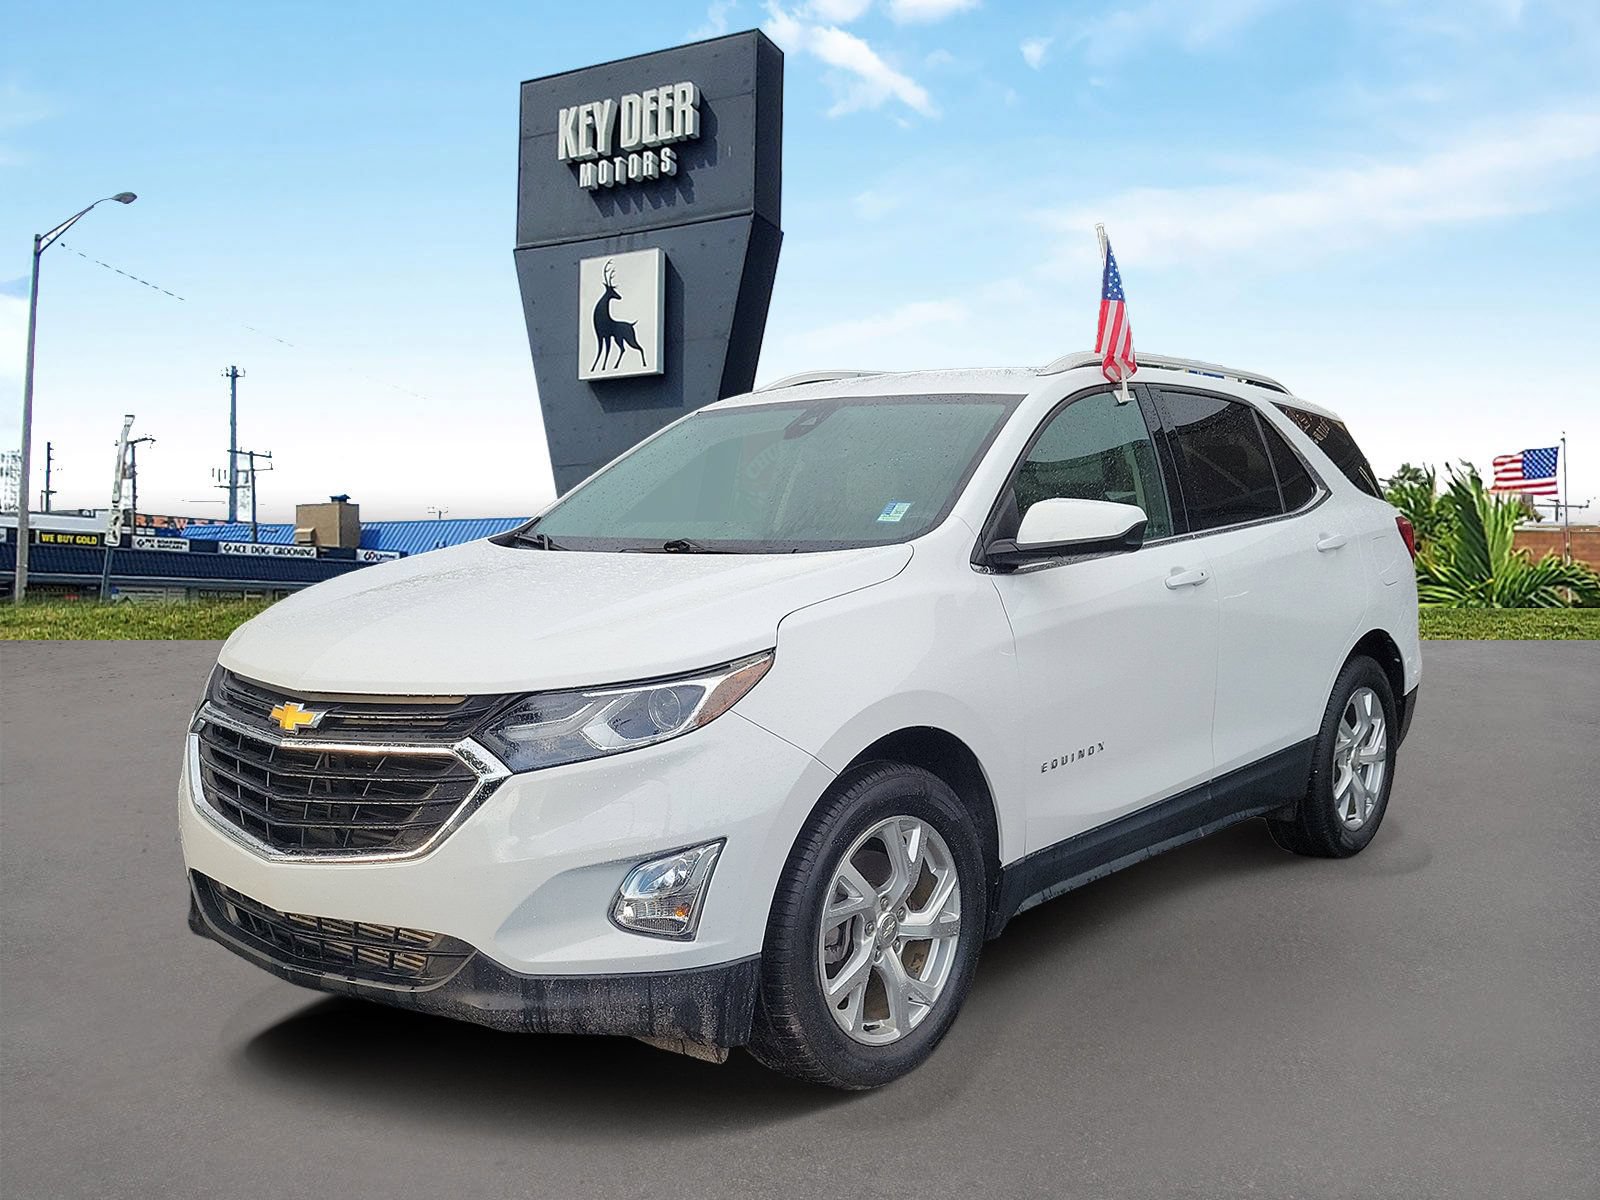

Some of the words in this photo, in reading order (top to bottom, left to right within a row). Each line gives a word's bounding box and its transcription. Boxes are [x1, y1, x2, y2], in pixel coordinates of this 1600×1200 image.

[557, 98, 617, 163] KEY
[620, 81, 700, 152] DEER
[579, 146, 677, 190] MOTORS
[41, 533, 55, 543] WE
[57, 534, 74, 544] BUY
[76, 535, 97, 545] GOLD
[233, 545, 248, 554] ACE
[251, 545, 270, 555] DOG
[273, 546, 315, 557] GROOMING
[1041, 741, 1104, 773] EQUINOX
